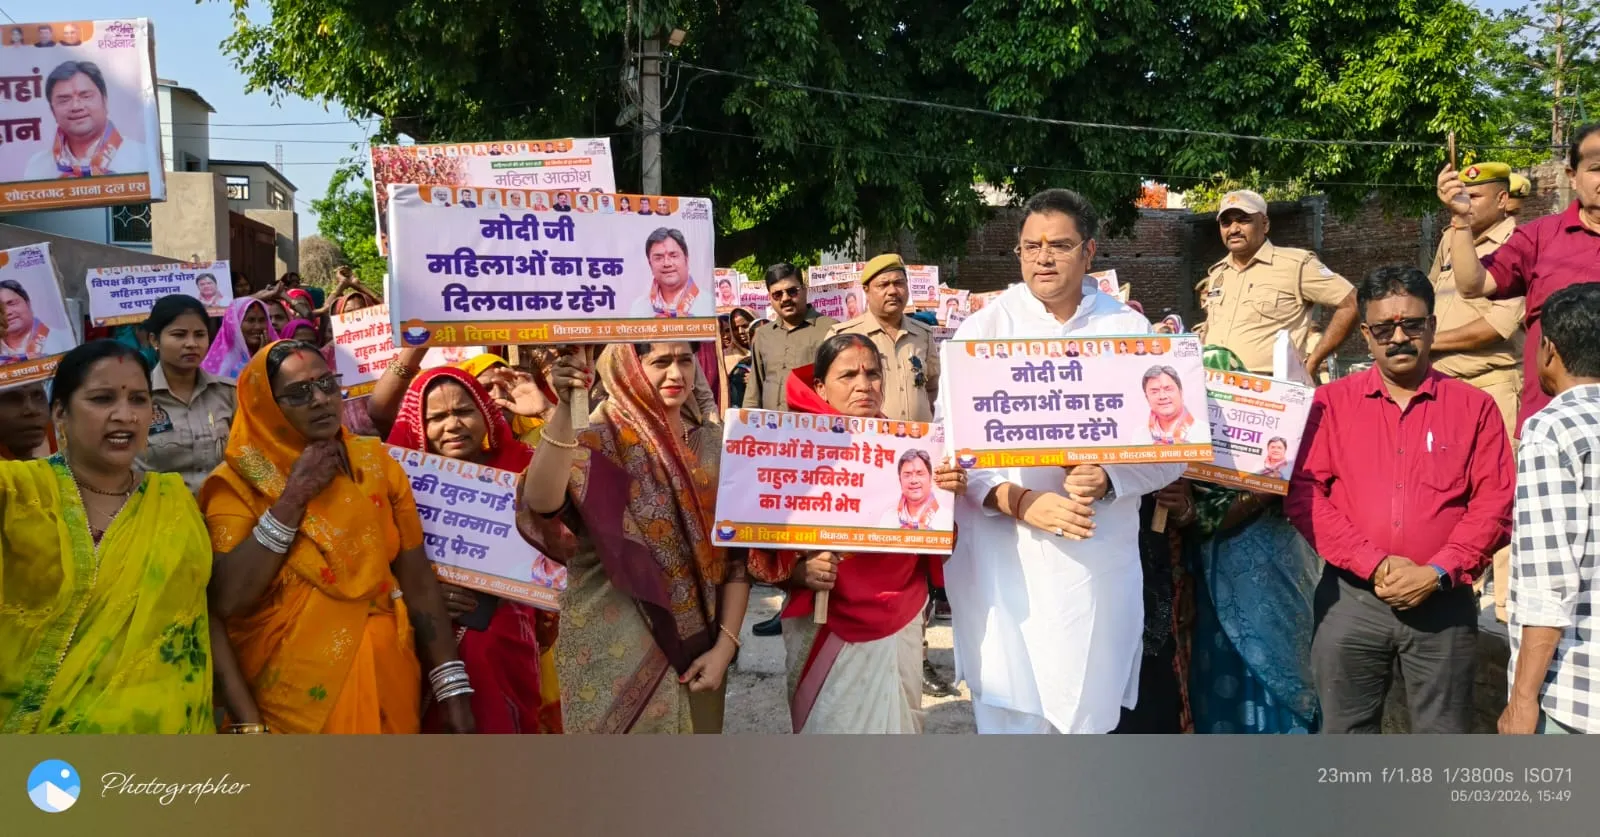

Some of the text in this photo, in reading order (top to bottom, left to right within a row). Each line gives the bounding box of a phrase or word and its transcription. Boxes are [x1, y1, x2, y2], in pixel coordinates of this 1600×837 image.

[0, 118, 41, 146] ान
[69, 184, 101, 197] अपना
[105, 182, 124, 194] दल
[129, 180, 146, 193] एस
[494, 168, 592, 187] महिला आक्रोश
[480, 213, 574, 241] मोदी जी
[427, 247, 624, 278] महिलाओं का हक
[91, 272, 195, 288] विपक्ष की खुल गई पोल
[110, 286, 180, 299] महिला सम्मान
[442, 283, 615, 313] दिलवाकर रहेंगे
[119, 301, 132, 310] पर
[336, 323, 375, 345] महिलाओं
[376, 323, 385, 336] से
[435, 325, 456, 342] श्री
[464, 324, 510, 341] विनय
[518, 324, 548, 340] वर्मा
[661, 323, 684, 333] अपना
[686, 324, 700, 332] दल
[702, 323, 715, 332] एस
[354, 345, 377, 360] राहुल
[11, 365, 39, 377] अपना
[358, 364, 370, 374] का
[1011, 360, 1083, 383] मोदी जी
[973, 389, 1124, 414] महिलाओं का हक
[984, 417, 1118, 443] दिलवाकर रहेंगे
[1227, 408, 1281, 430] आक्रोश
[1222, 424, 1263, 443] यात्रा
[726, 435, 896, 468] महिलाओं से इनको है द्वेष
[979, 452, 996, 466] श्री
[1000, 452, 1035, 466] विनय
[1040, 450, 1065, 465] वर्मा
[1160, 449, 1181, 458] अपना
[1183, 449, 1197, 457] दल
[757, 466, 864, 489] राहुल अखिलेश
[412, 474, 439, 495] की
[440, 483, 479, 505] खुल
[480, 490, 515, 512] गई
[759, 493, 861, 513] का असली भेष
[443, 510, 512, 538] सम्मान
[739, 527, 753, 541] श्री
[758, 527, 789, 541] विनय
[795, 528, 817, 542] वर्मा
[904, 535, 925, 543] अपना
[925, 536, 938, 544] दल
[450, 534, 489, 560] फेल
